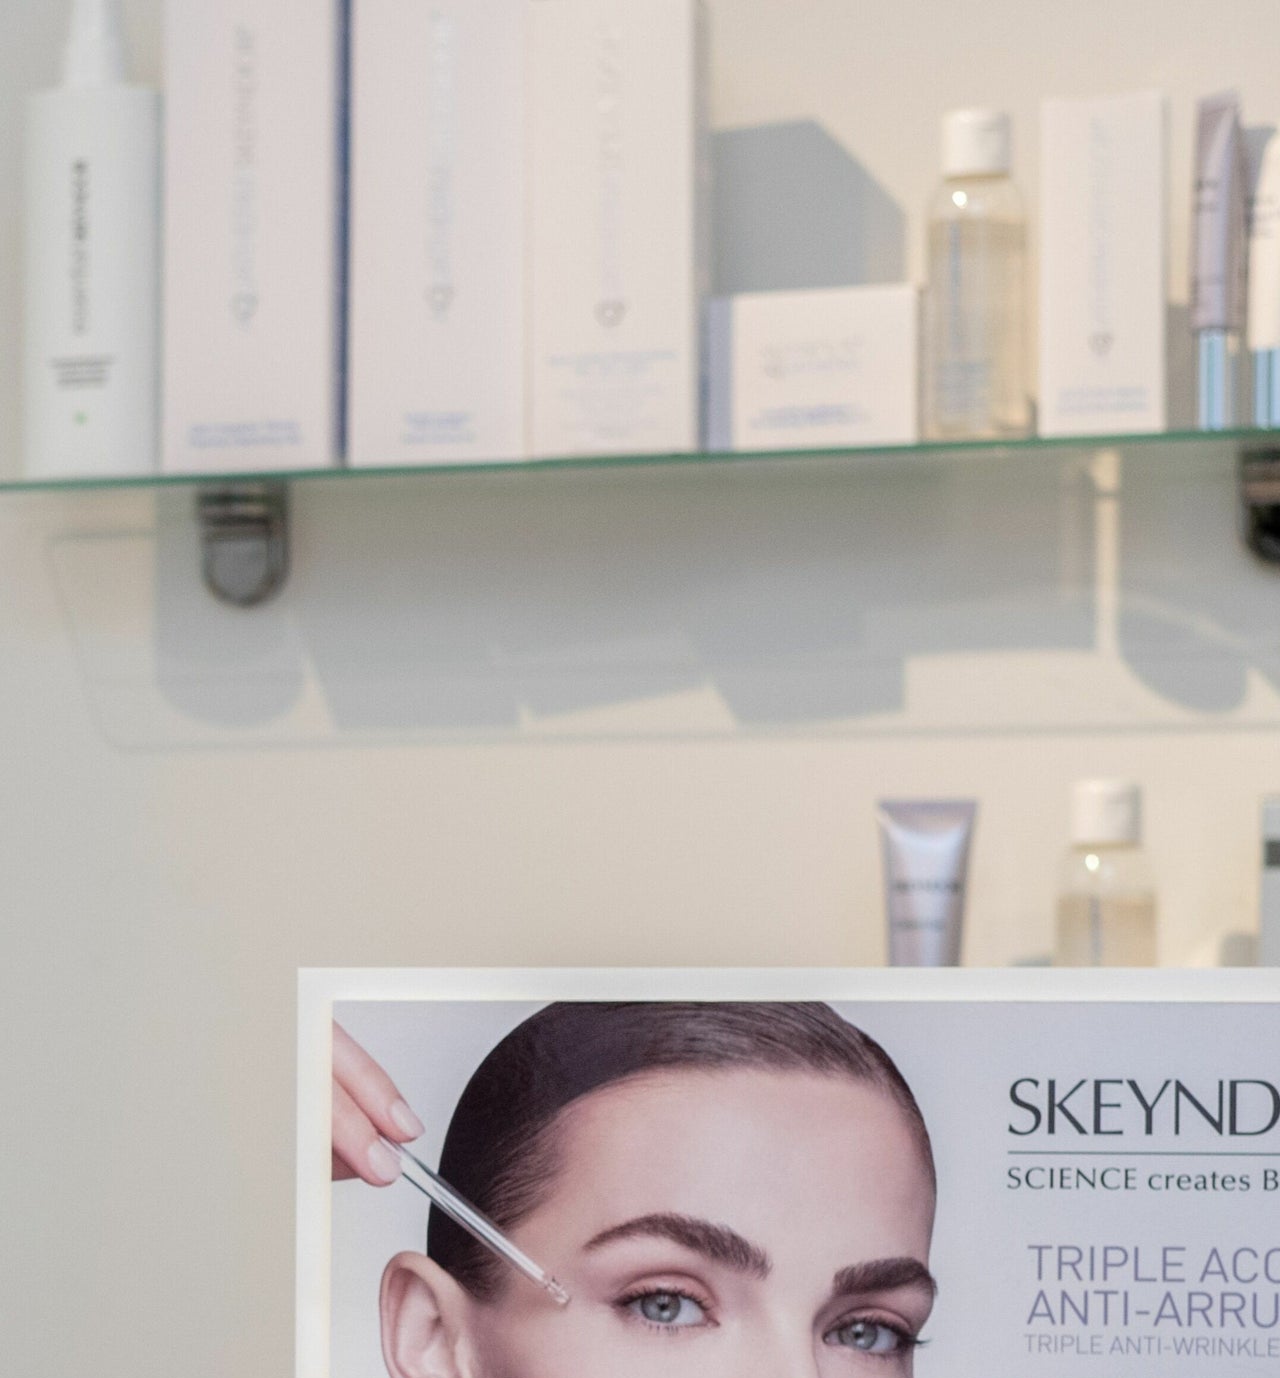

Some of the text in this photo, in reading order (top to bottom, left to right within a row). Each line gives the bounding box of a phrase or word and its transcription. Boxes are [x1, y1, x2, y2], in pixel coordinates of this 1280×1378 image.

[1008, 1077, 1280, 1136] SKEYND
[1007, 1166, 1137, 1190] SCIENCE
[1147, 1170, 1251, 1192] creates
[1026, 1245, 1186, 1283] TRIPLE
[1026, 1289, 1280, 1329] ANTI-ARRU
[1023, 1333, 1280, 1359] TRIPLE ANTI-WRINKLE
